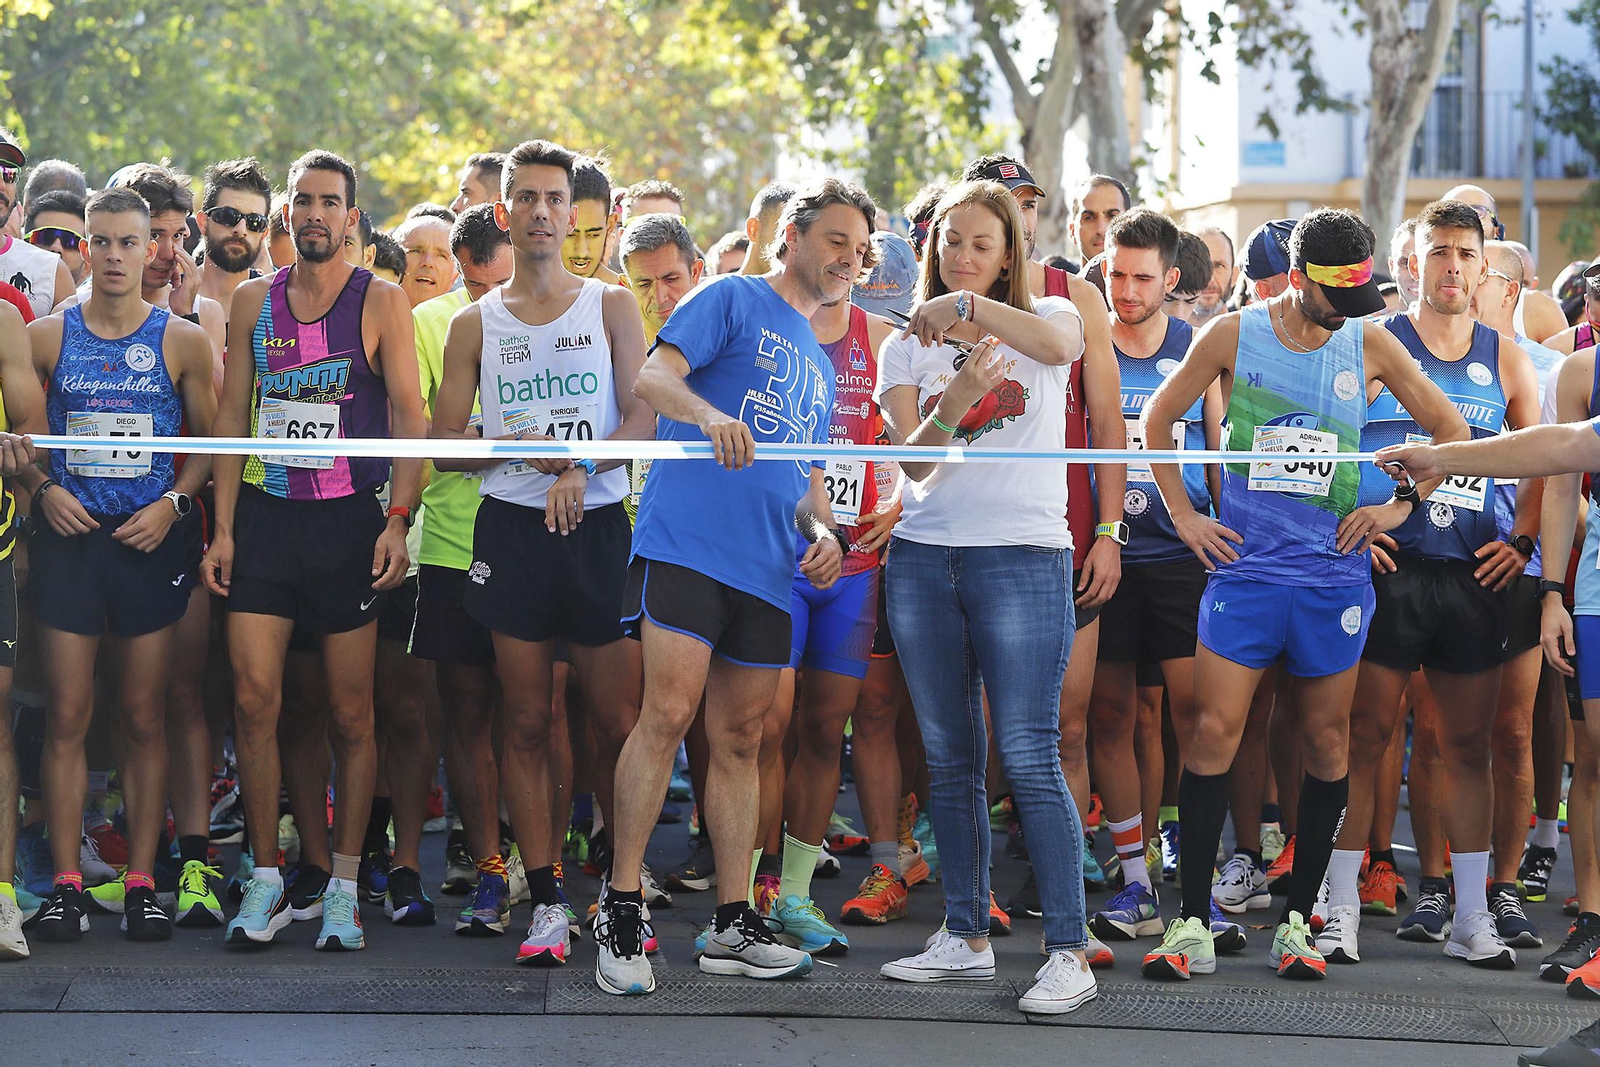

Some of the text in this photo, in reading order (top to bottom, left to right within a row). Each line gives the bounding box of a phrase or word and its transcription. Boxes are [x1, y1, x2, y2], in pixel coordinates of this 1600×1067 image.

[499, 335, 530, 346] bathco
[555, 334, 592, 348] JULIÁN
[761, 327, 792, 350] VUELTA
[501, 343, 529, 353] running
[500, 350, 531, 365] TEAM
[61, 374, 161, 395] Kekaganchillea
[497, 368, 598, 405] bathco
[747, 388, 777, 405] HUELVA
[550, 407, 579, 416] ENRIQUE
[79, 424, 98, 432] VUELTA
[287, 420, 334, 438] 667
[516, 418, 537, 429] VUELTA
[1264, 438, 1283, 447] VUELTA
[1299, 433, 1322, 443] ADRIAN
[836, 463, 852, 472] PABLO
[824, 475, 858, 507] 321
